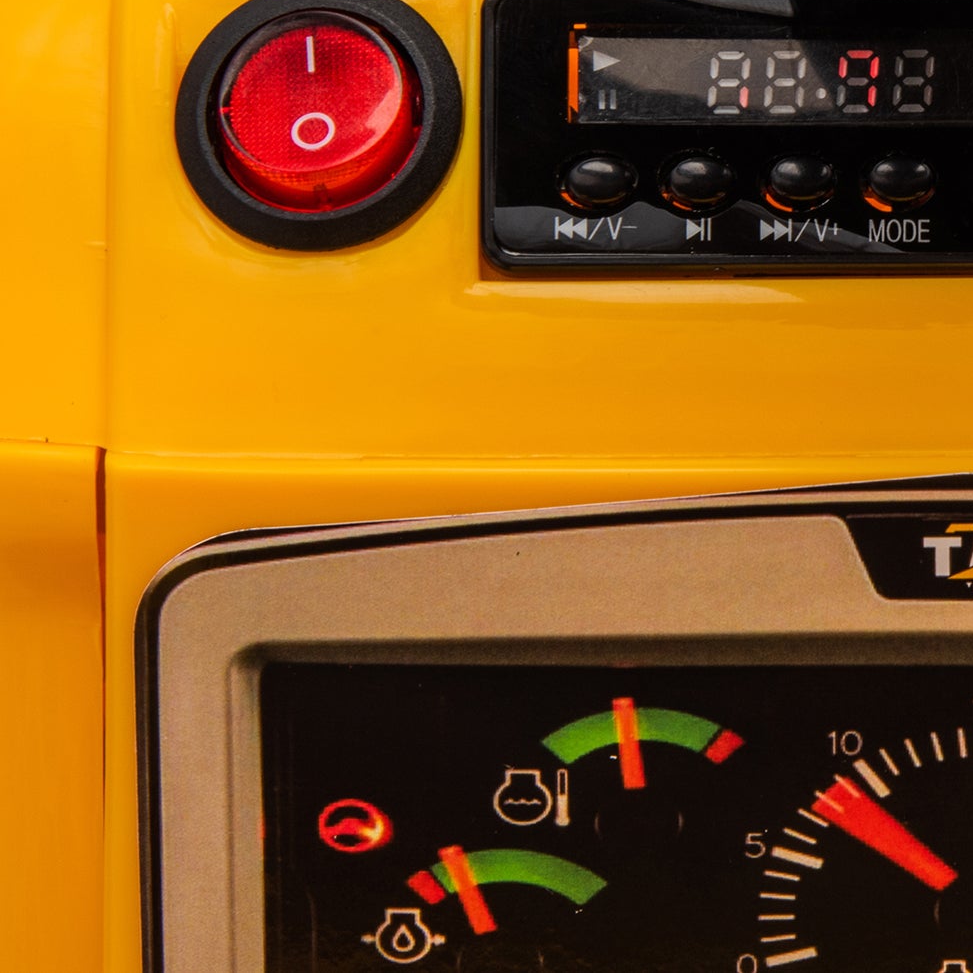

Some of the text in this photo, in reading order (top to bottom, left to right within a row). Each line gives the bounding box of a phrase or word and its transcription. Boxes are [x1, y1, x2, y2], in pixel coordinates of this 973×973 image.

[868, 219, 931, 243] MODE
[828, 730, 863, 756] 10
[744, 833, 766, 858] 5
